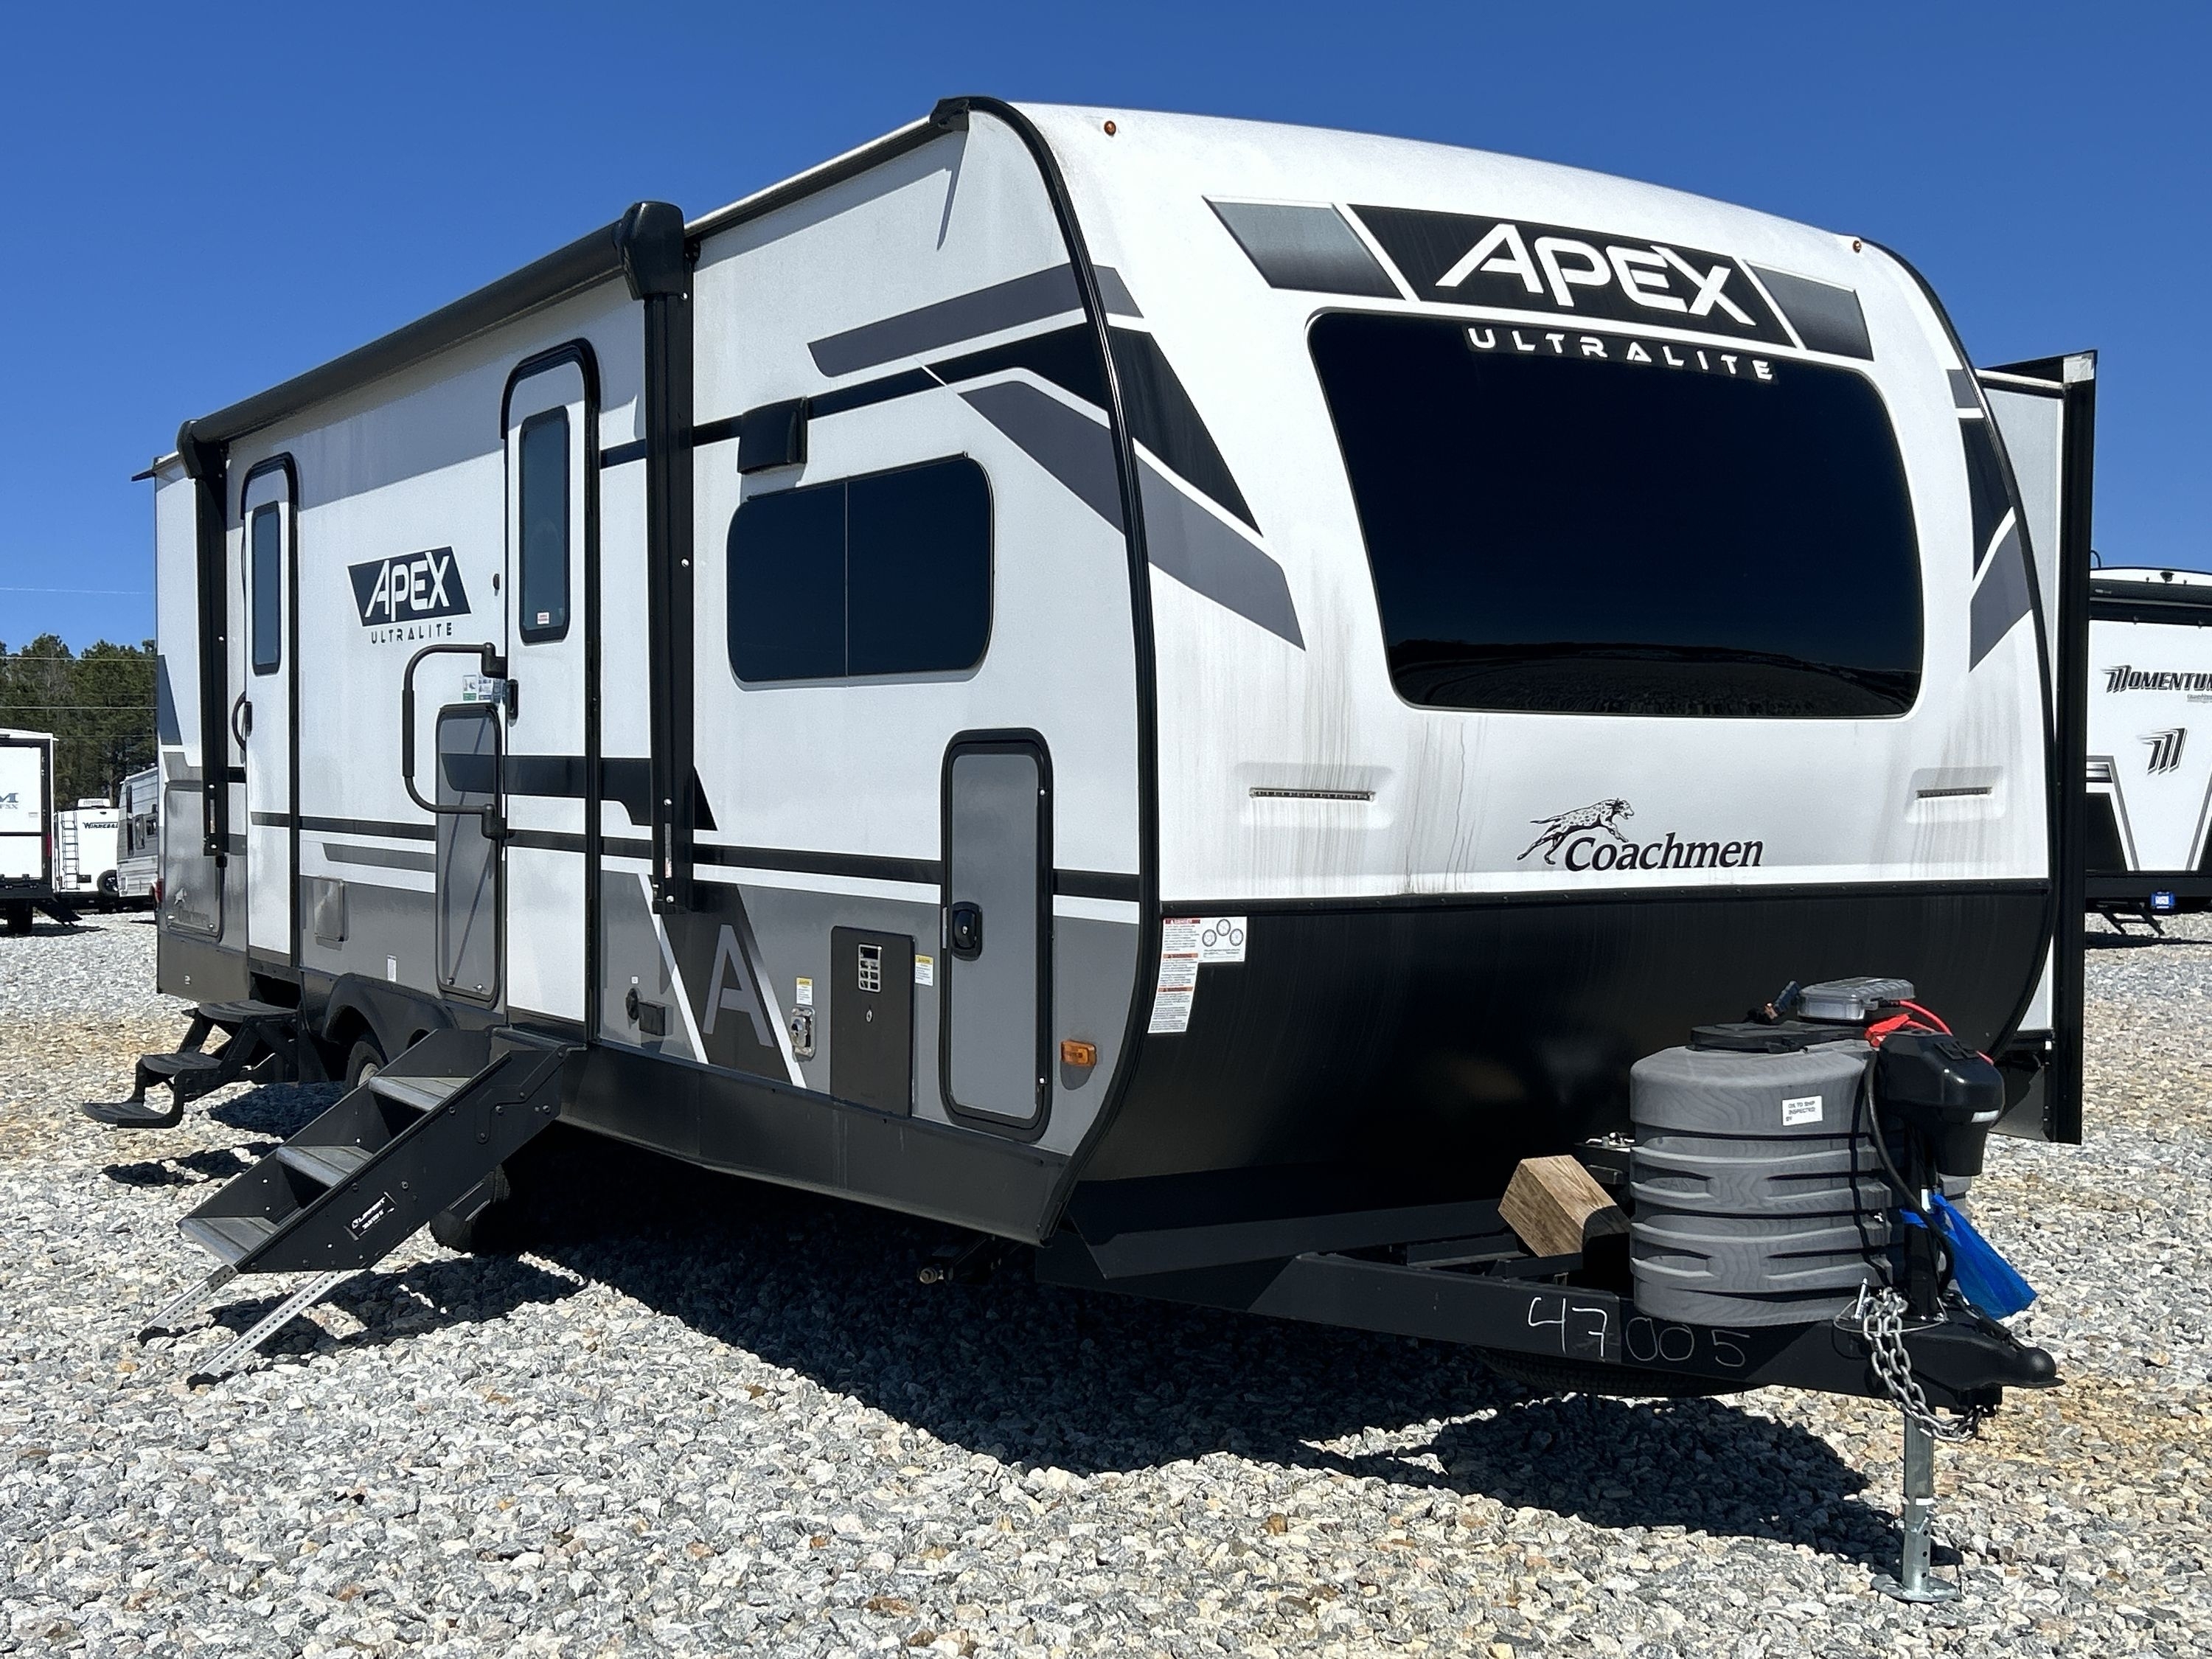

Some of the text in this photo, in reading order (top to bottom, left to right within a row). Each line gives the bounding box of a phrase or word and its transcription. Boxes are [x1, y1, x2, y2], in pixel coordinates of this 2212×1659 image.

[1435, 223, 1756, 326] APEX
[1468, 327, 1773, 380] ULTRALITE
[364, 552, 450, 622] APEX
[371, 622, 452, 644] ULTRALITE
[1565, 832, 1763, 872] Coachmen
